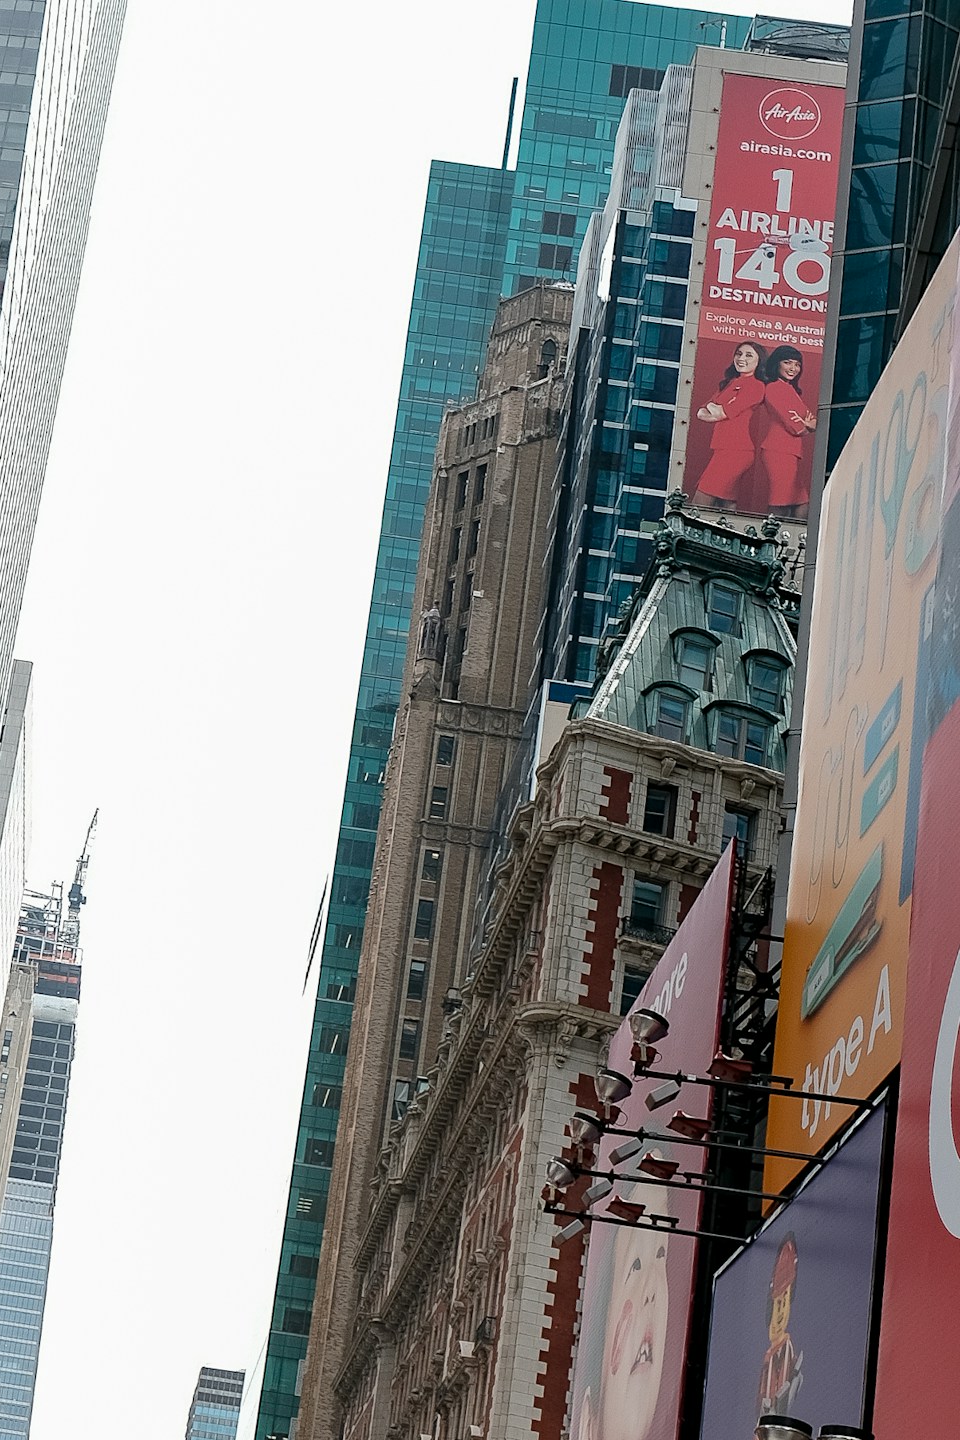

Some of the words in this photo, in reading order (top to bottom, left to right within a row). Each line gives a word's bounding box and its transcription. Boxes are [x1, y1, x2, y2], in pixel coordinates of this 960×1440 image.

[765, 102, 816, 123] AirAsia
[740, 140, 832, 162] airasia.com
[772, 168, 794, 213] 1
[716, 207, 834, 243] AIRLINE
[713, 237, 832, 296] 140
[705, 312, 746, 326] Explore
[748, 317, 772, 331] Asia
[774, 321, 782, 331] &
[712, 325, 735, 336] with
[738, 326, 756, 338] the
[757, 328, 797, 344] world's
[800, 335, 824, 347] best
[801, 1014, 864, 1139] type
[867, 962, 893, 1056] A
